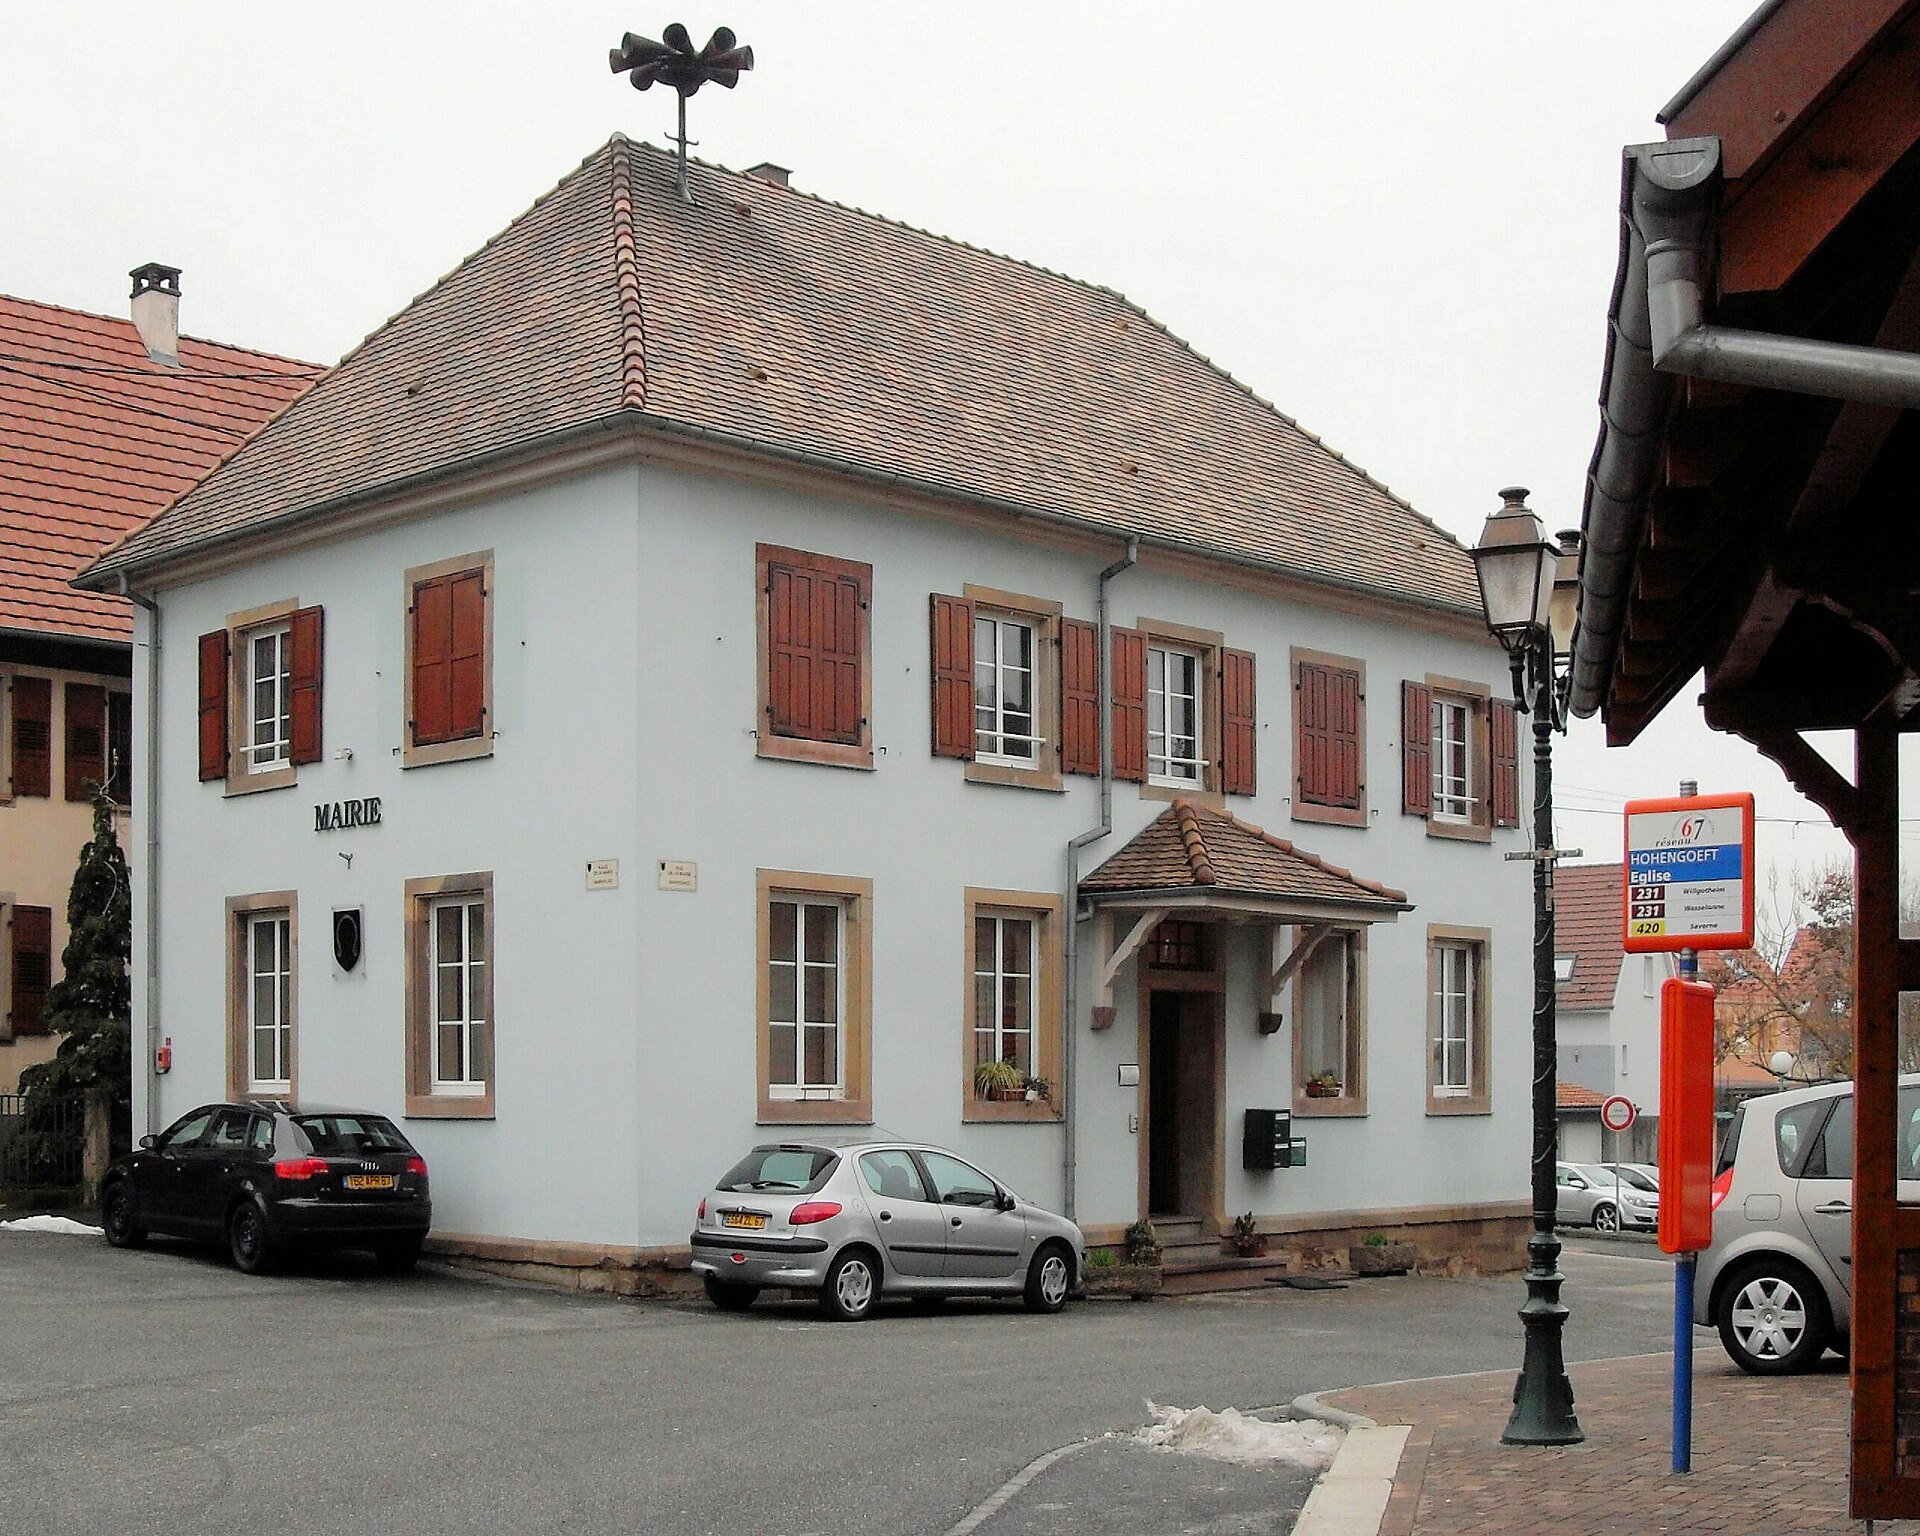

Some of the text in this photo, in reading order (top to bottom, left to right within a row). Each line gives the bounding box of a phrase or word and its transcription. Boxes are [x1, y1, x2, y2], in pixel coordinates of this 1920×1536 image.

[314, 797, 382, 831] MAIRIE
[1681, 817, 1705, 840] 67
[1655, 836, 1691, 847] réseau
[1630, 849, 1719, 865] HOHENGOEFT
[1630, 869, 1672, 884] Eglise
[1636, 887, 1660, 900] 231
[1636, 905, 1660, 918] 231
[1636, 923, 1660, 934] 420
